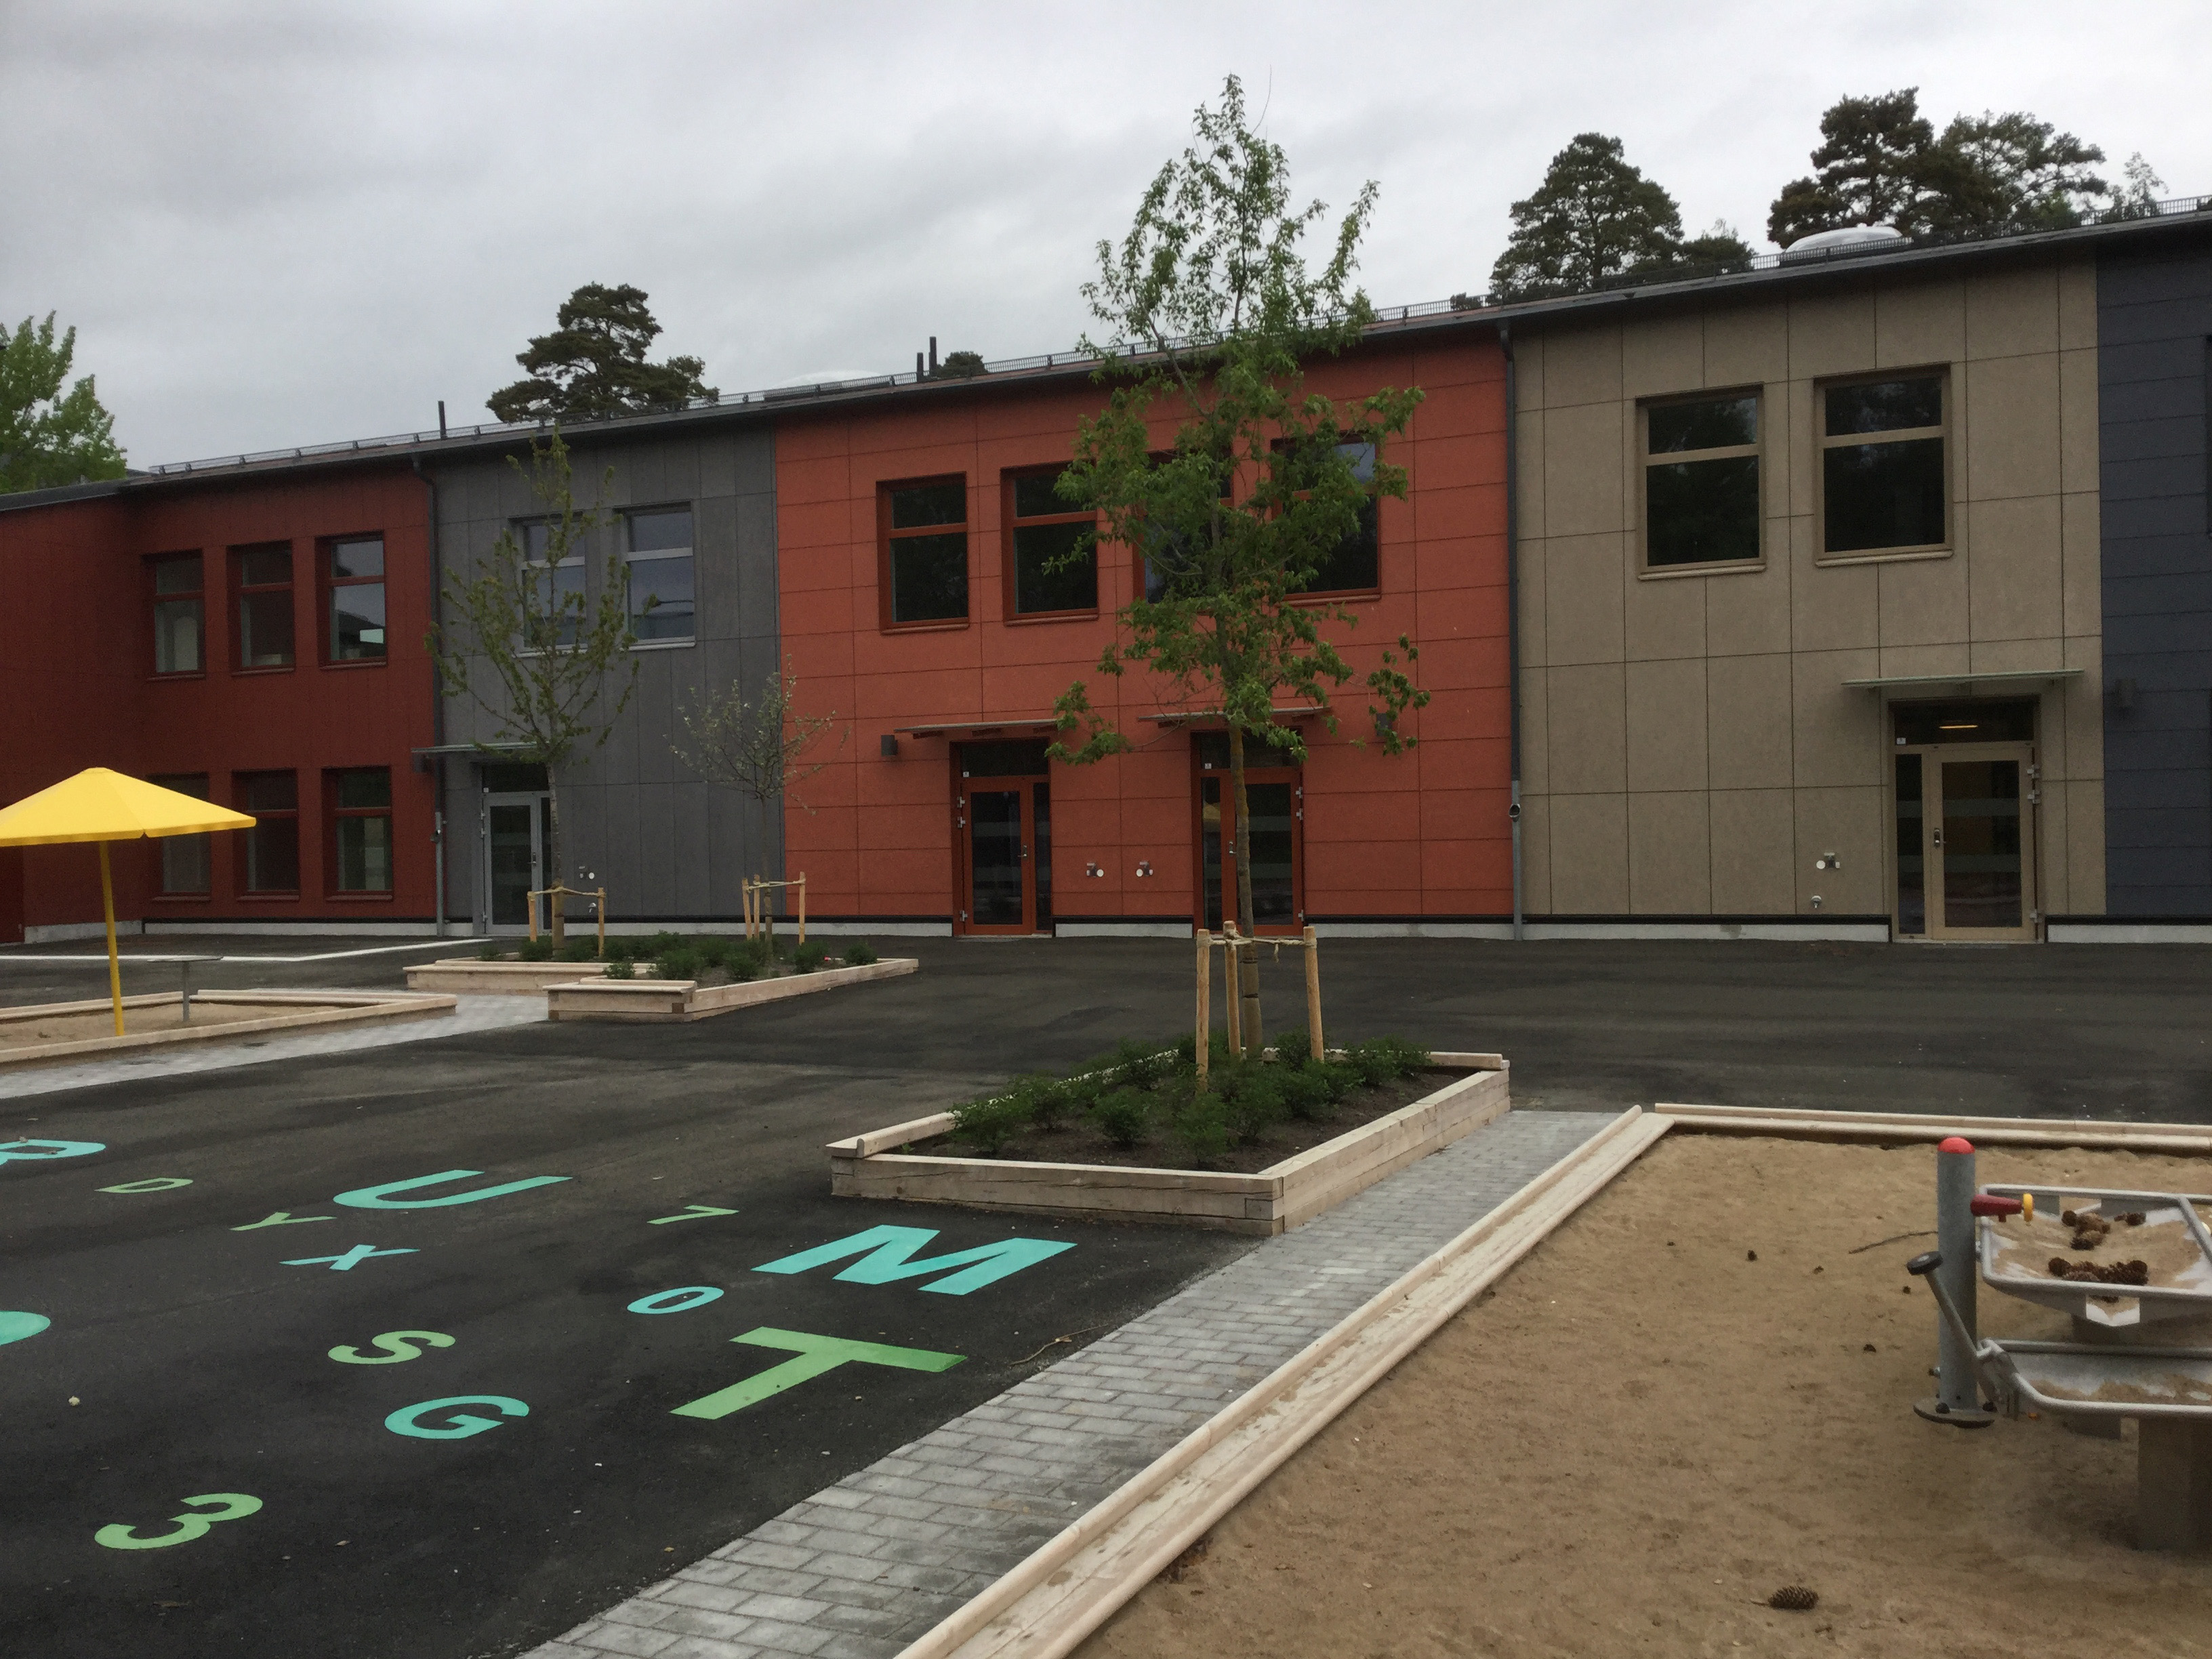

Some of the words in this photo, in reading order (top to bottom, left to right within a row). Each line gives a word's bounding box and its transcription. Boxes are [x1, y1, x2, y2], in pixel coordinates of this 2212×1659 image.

[94, 1177, 194, 1193] D
[333, 1170, 573, 1209] U
[229, 1212, 337, 1231] Y
[279, 1244, 422, 1271] X
[750, 1225, 1078, 1295] M
[327, 1330, 457, 1364] S
[668, 1326, 968, 1420] T
[384, 1395, 530, 1439] G
[94, 1493, 264, 1550] 3
